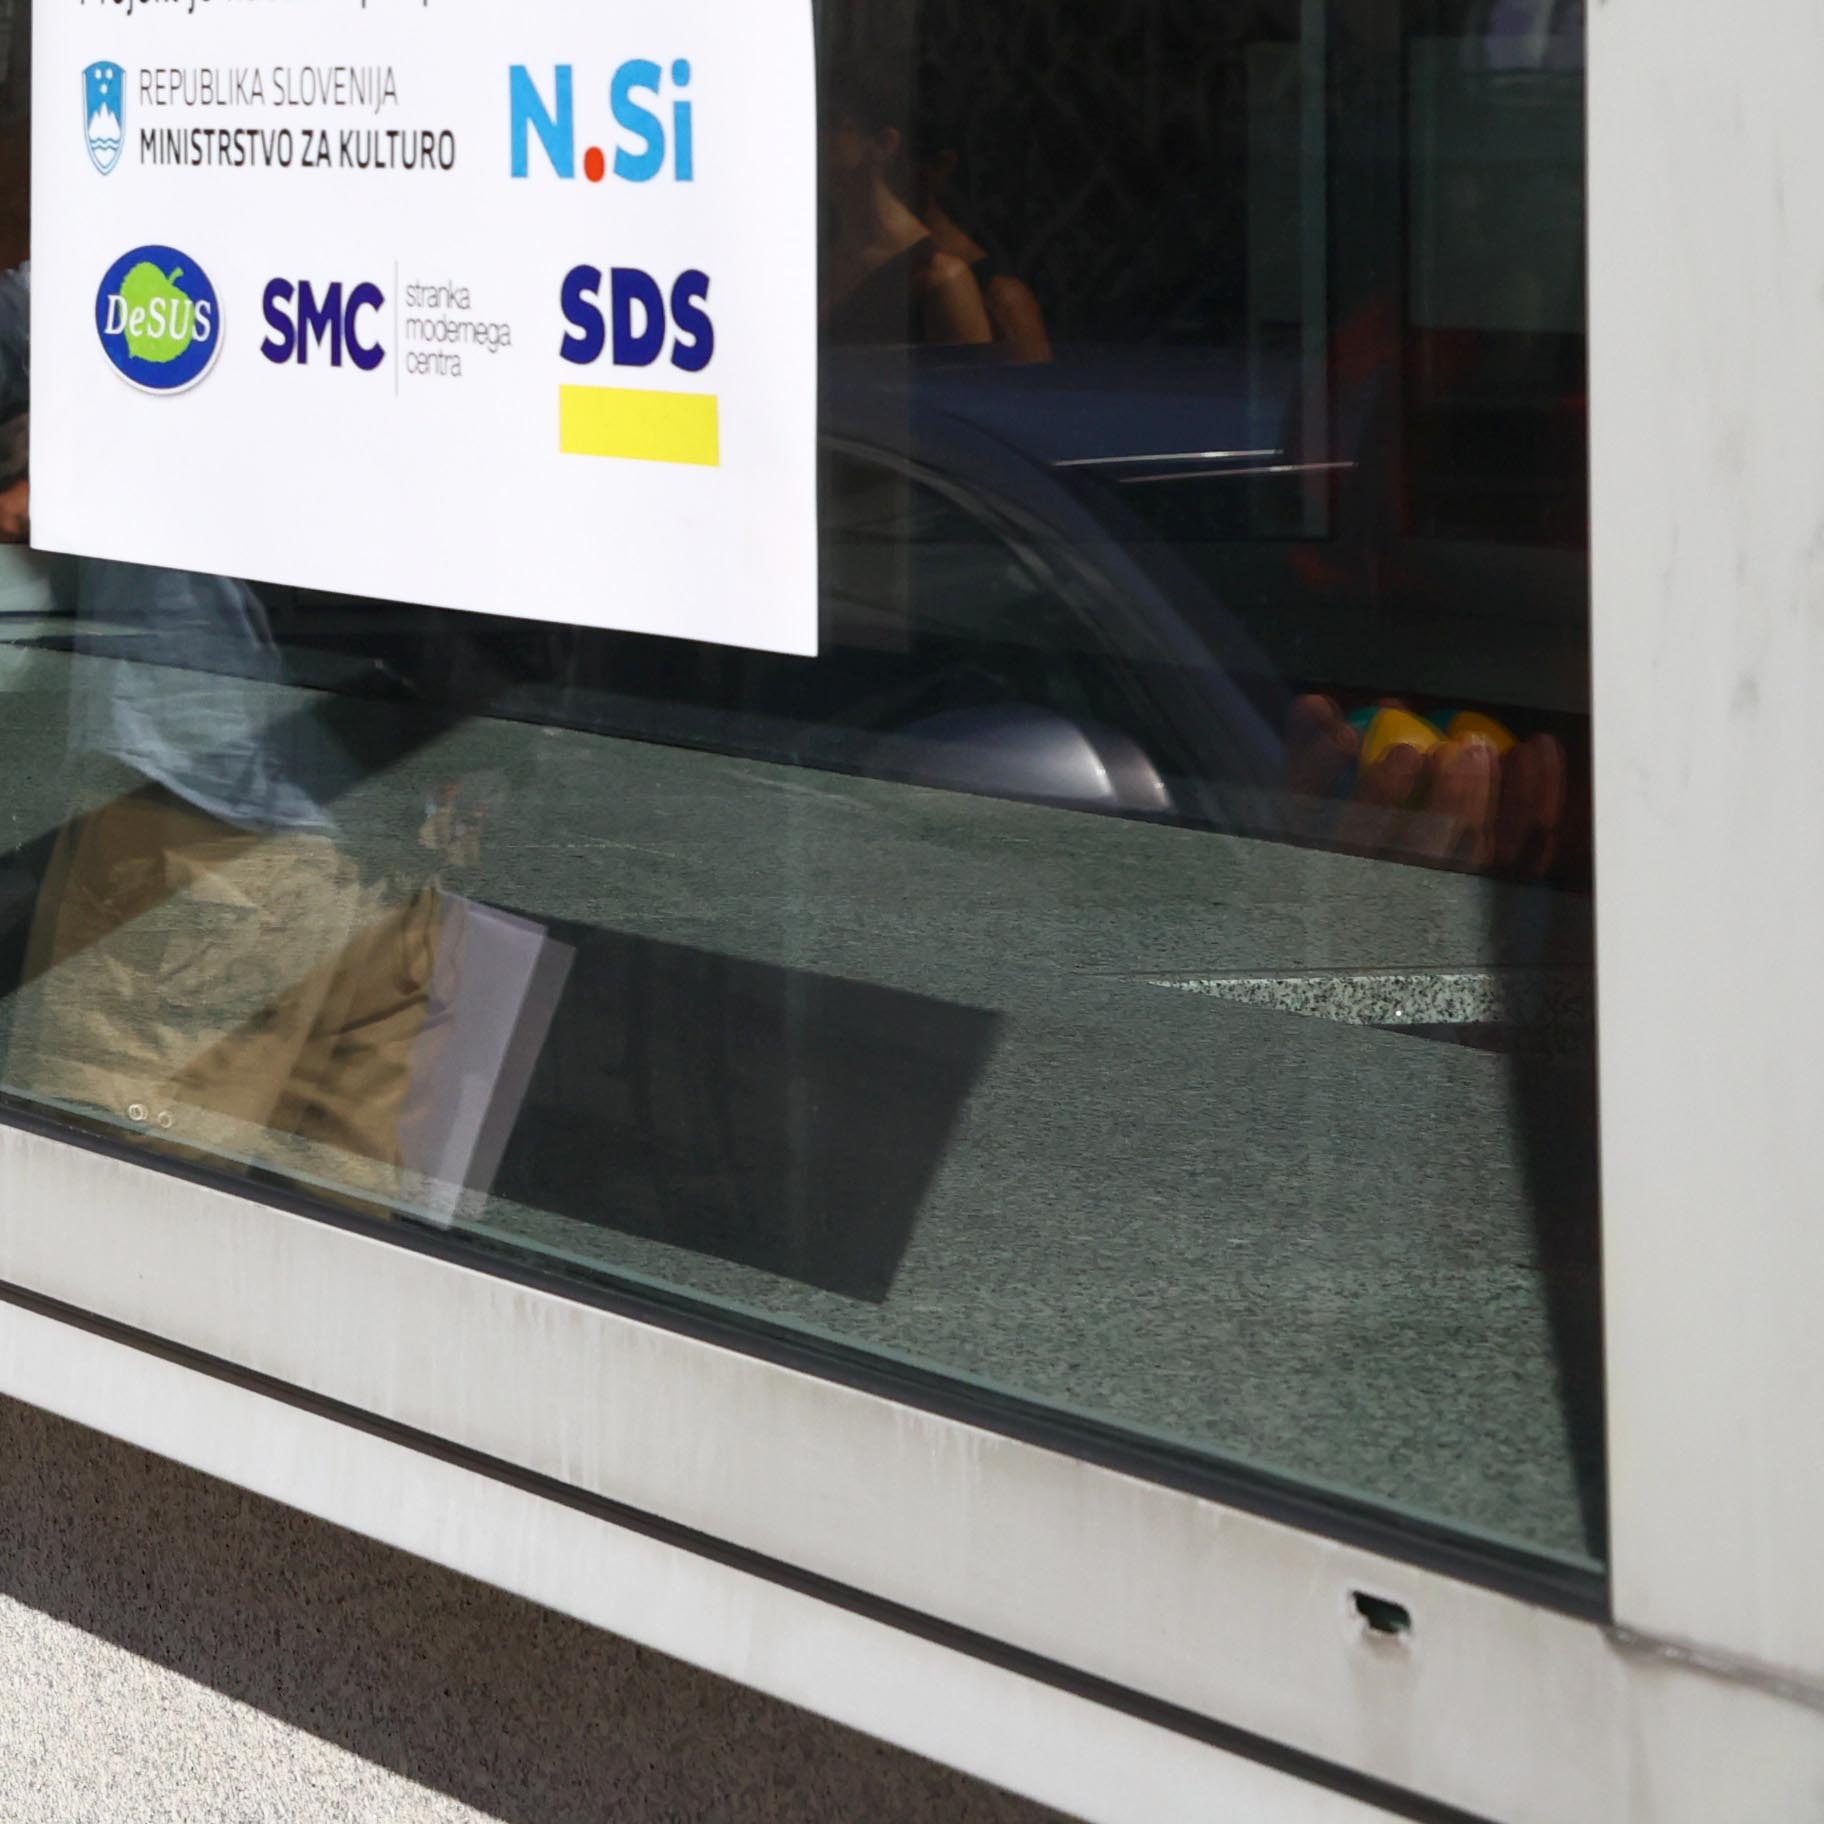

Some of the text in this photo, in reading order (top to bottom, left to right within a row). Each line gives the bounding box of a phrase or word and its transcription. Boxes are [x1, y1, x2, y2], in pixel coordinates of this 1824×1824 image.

[139, 65, 398, 115] REPUBLIKA SLOVENIJA
[140, 127, 456, 171] MINISTRSTVO ZA KULTURO
[104, 292, 212, 342] DeSUS
[405, 279, 472, 311] stranka
[559, 263, 715, 373] SDS
[260, 277, 386, 372] SMC
[405, 349, 463, 378] centra
